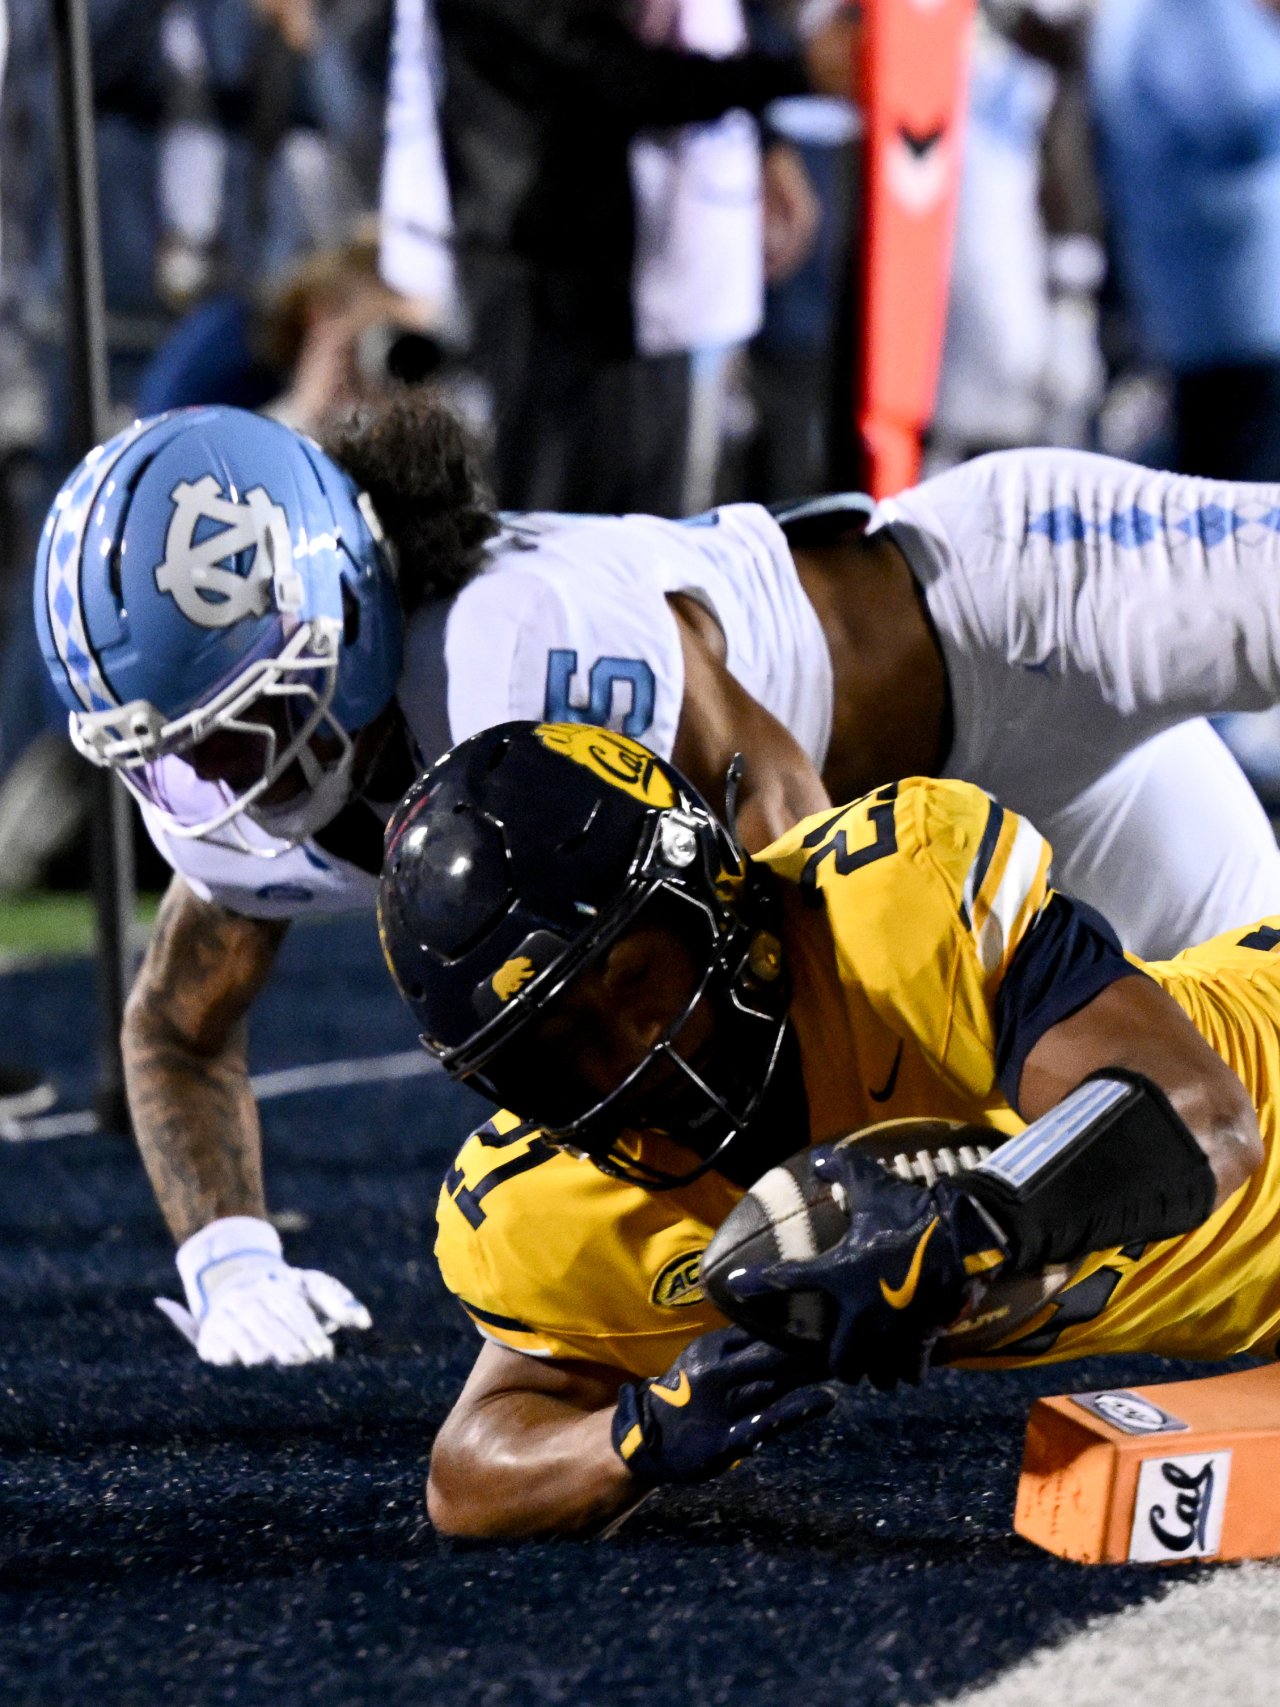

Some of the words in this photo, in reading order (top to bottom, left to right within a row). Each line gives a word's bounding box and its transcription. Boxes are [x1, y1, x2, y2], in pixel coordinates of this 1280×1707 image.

[545, 649, 656, 738] 5
[588, 733, 654, 795] Cal
[1148, 1459, 1215, 1552] Cal
